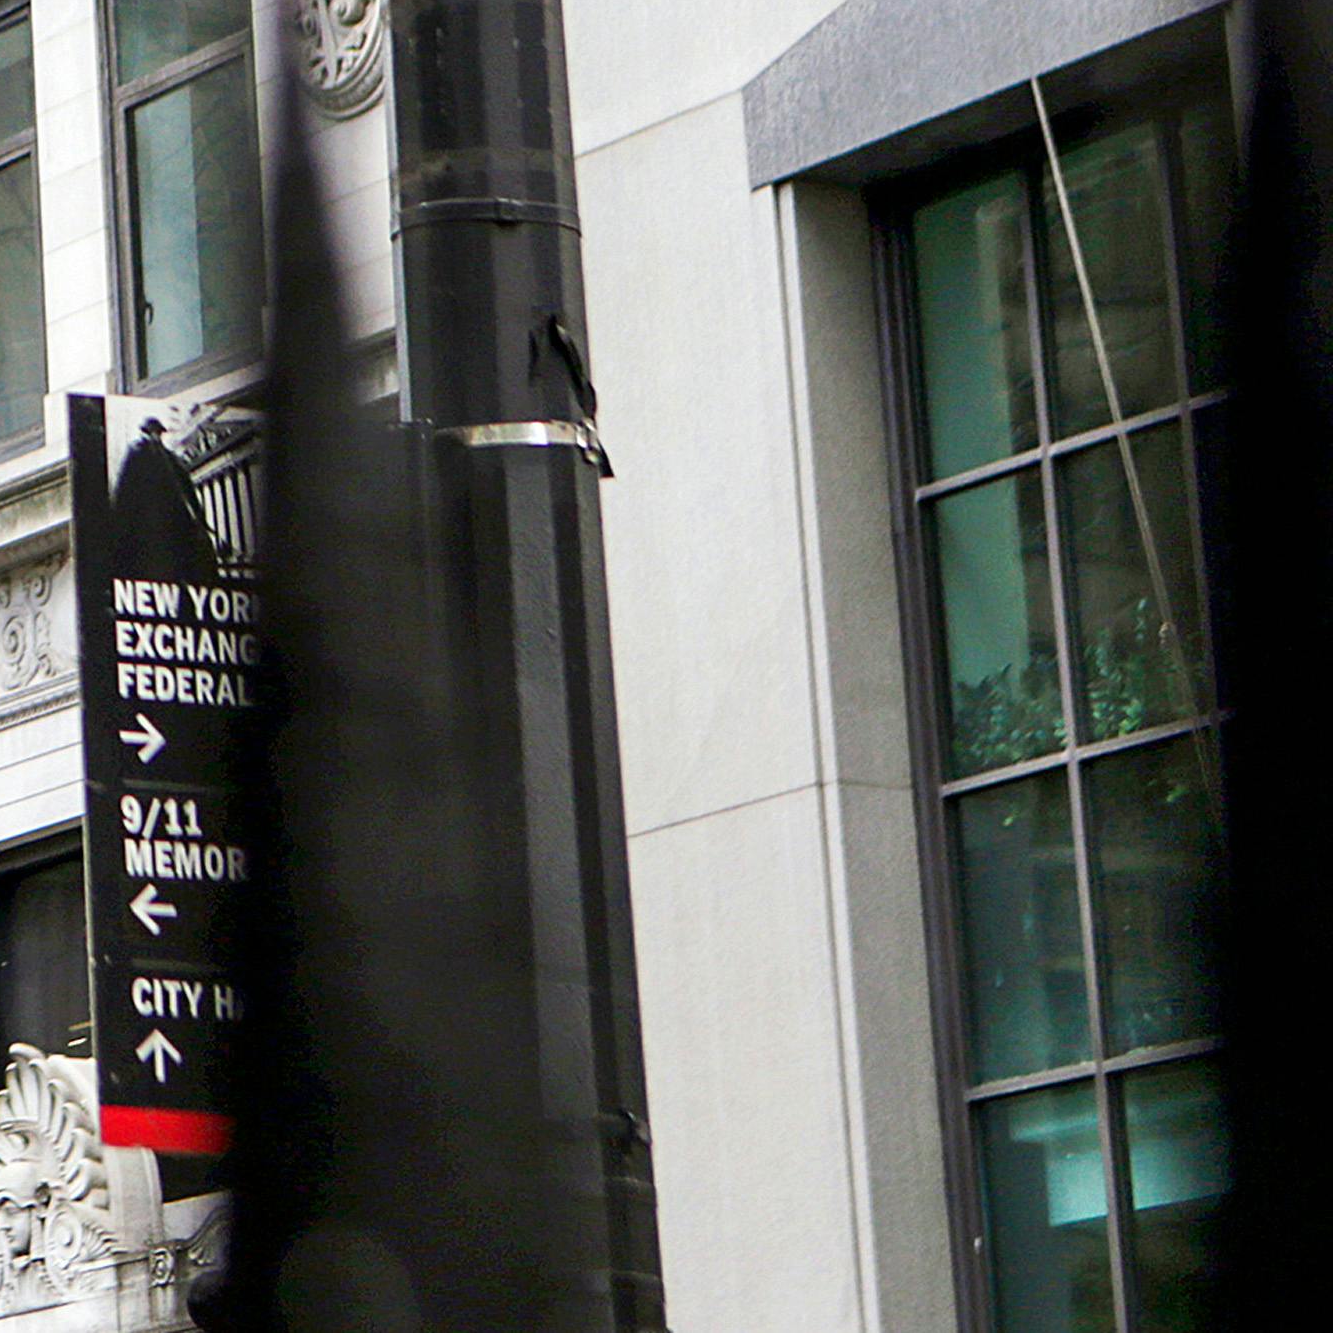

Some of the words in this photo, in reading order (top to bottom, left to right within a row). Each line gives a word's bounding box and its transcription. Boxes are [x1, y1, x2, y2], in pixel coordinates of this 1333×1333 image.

[113, 577, 180, 618] NEW
[115, 620, 258, 665] EXCHANG
[117, 662, 254, 707] FEDERAL
[120, 794, 203, 839] 9/11
[124, 838, 248, 882] MEMOR
[131, 976, 202, 1017] CITY
